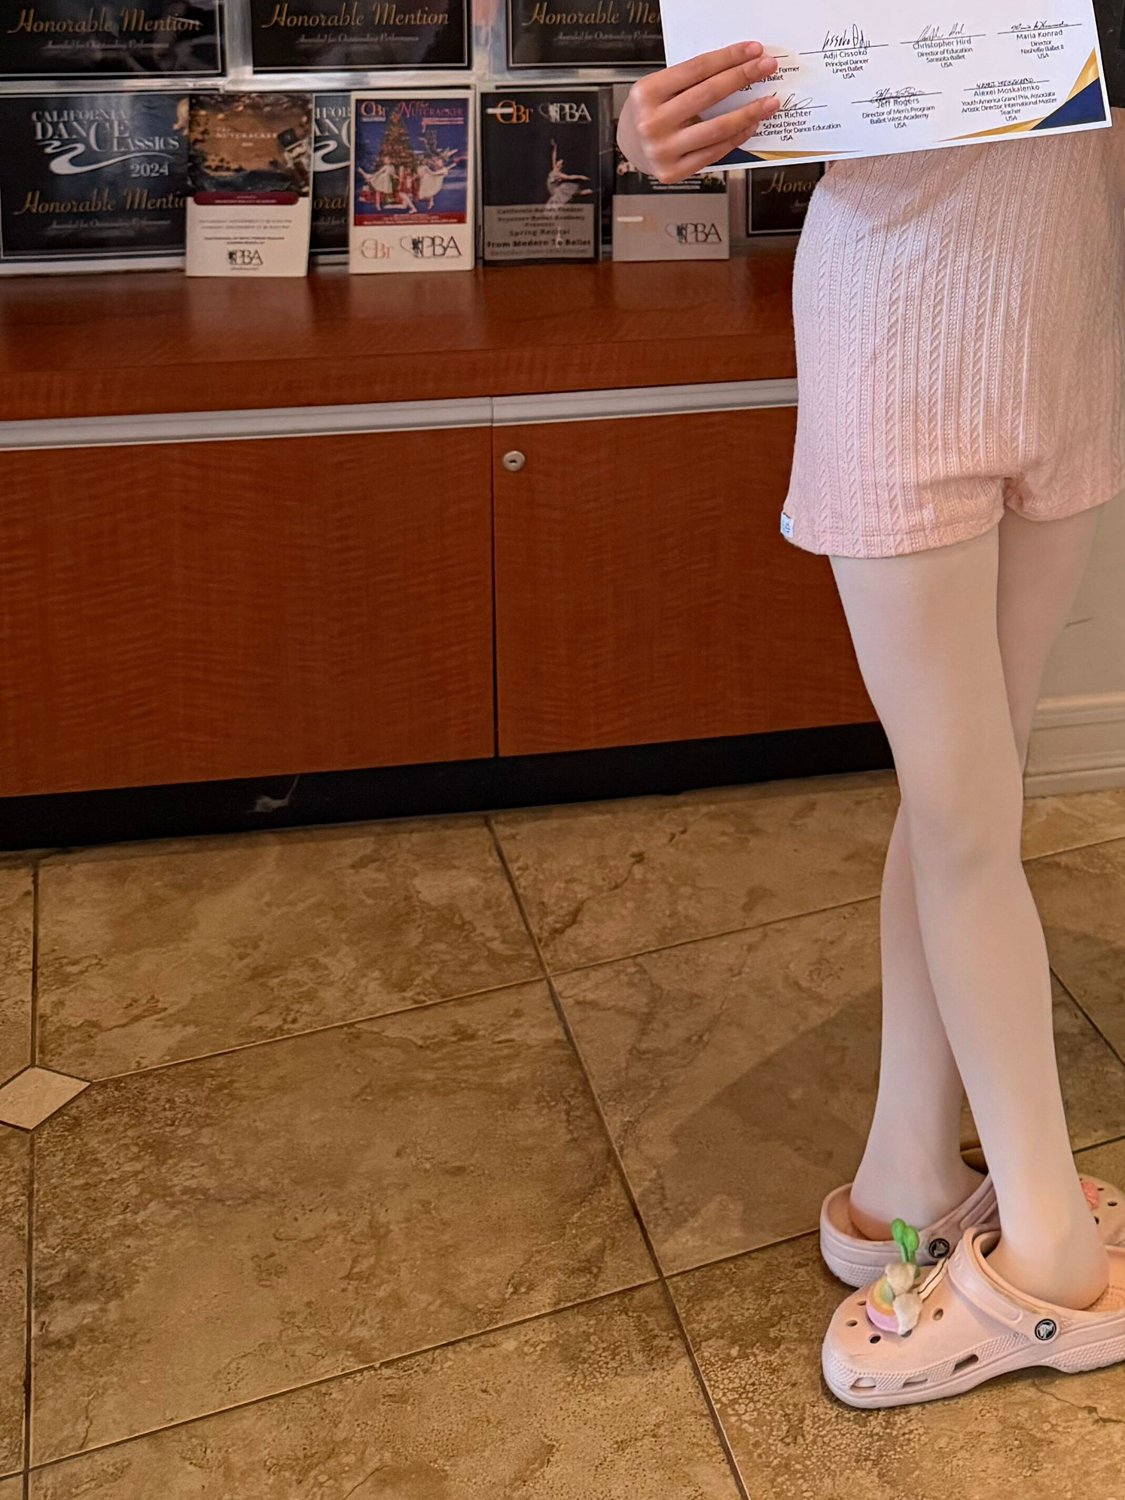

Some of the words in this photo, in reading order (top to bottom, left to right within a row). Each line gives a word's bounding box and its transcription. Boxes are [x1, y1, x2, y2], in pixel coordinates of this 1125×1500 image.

[262, 2, 364, 28] Honorable
[373, 3, 449, 25] Mention
[523, 1, 619, 26] Honorable
[8, 8, 112, 34] Honorable
[121, 8, 200, 31] Mention
[913, 40, 955, 50] Christopher
[998, 85, 1040, 94] Moskalenko
[893, 98, 919, 107] Rogers
[32, 110, 127, 122] CALIFORNIA
[784, 110, 811, 118] Richter
[763, 121, 782, 129] School
[783, 120, 806, 128] Director
[131, 163, 169, 178] 2024
[13, 188, 115, 215] Honorable
